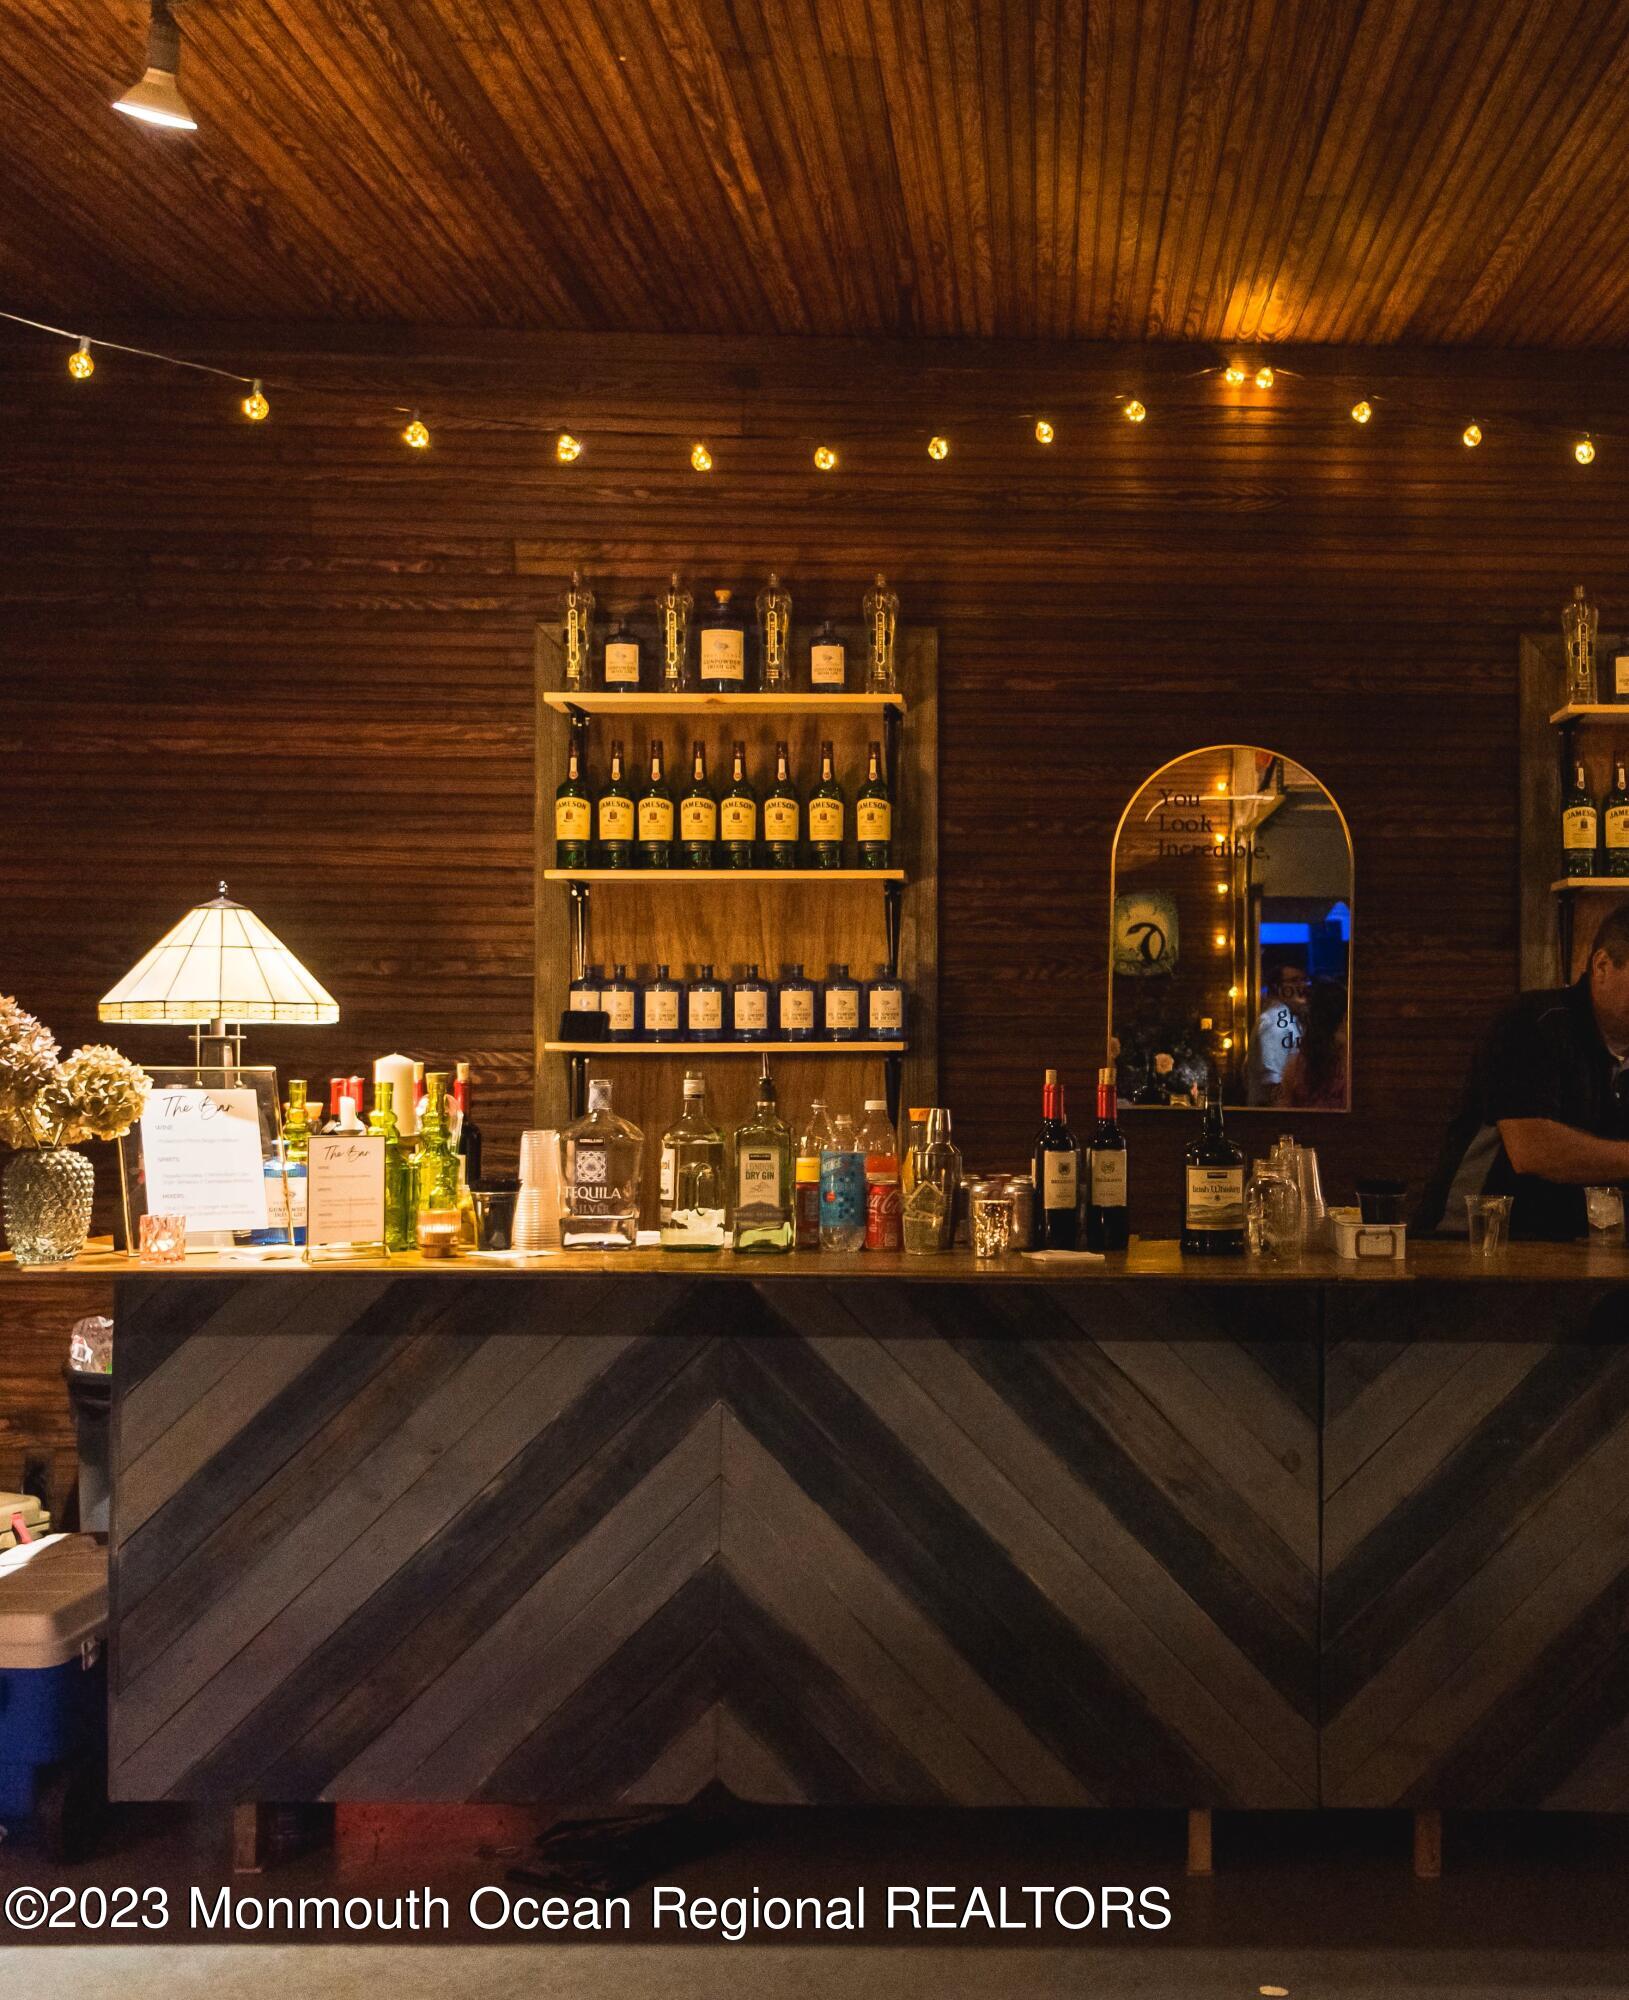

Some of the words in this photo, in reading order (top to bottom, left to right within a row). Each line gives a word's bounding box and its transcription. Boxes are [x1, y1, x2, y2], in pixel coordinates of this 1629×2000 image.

[1159, 788, 1201, 808] You
[558, 801, 586, 810] JAMESON
[600, 800, 630, 810] JAMESON
[640, 801, 670, 810] JAMESON
[682, 801, 714, 810] JAMESON
[724, 801, 754, 810] JAMESON
[767, 801, 796, 810] JAMESON
[811, 801, 840, 811] JAMESON
[859, 801, 888, 811] JAMESON
[1159, 814, 1213, 833] Look
[162, 1095, 194, 1118] The
[200, 1095, 235, 1120] Bar
[323, 1144, 345, 1161] The
[346, 1144, 370, 1163] Bar
[745, 1170, 760, 1180] DRY
[761, 1170, 775, 1180] GIN
[564, 1186, 622, 1203] TEQUILA
[572, 1203, 610, 1214] SILVER
